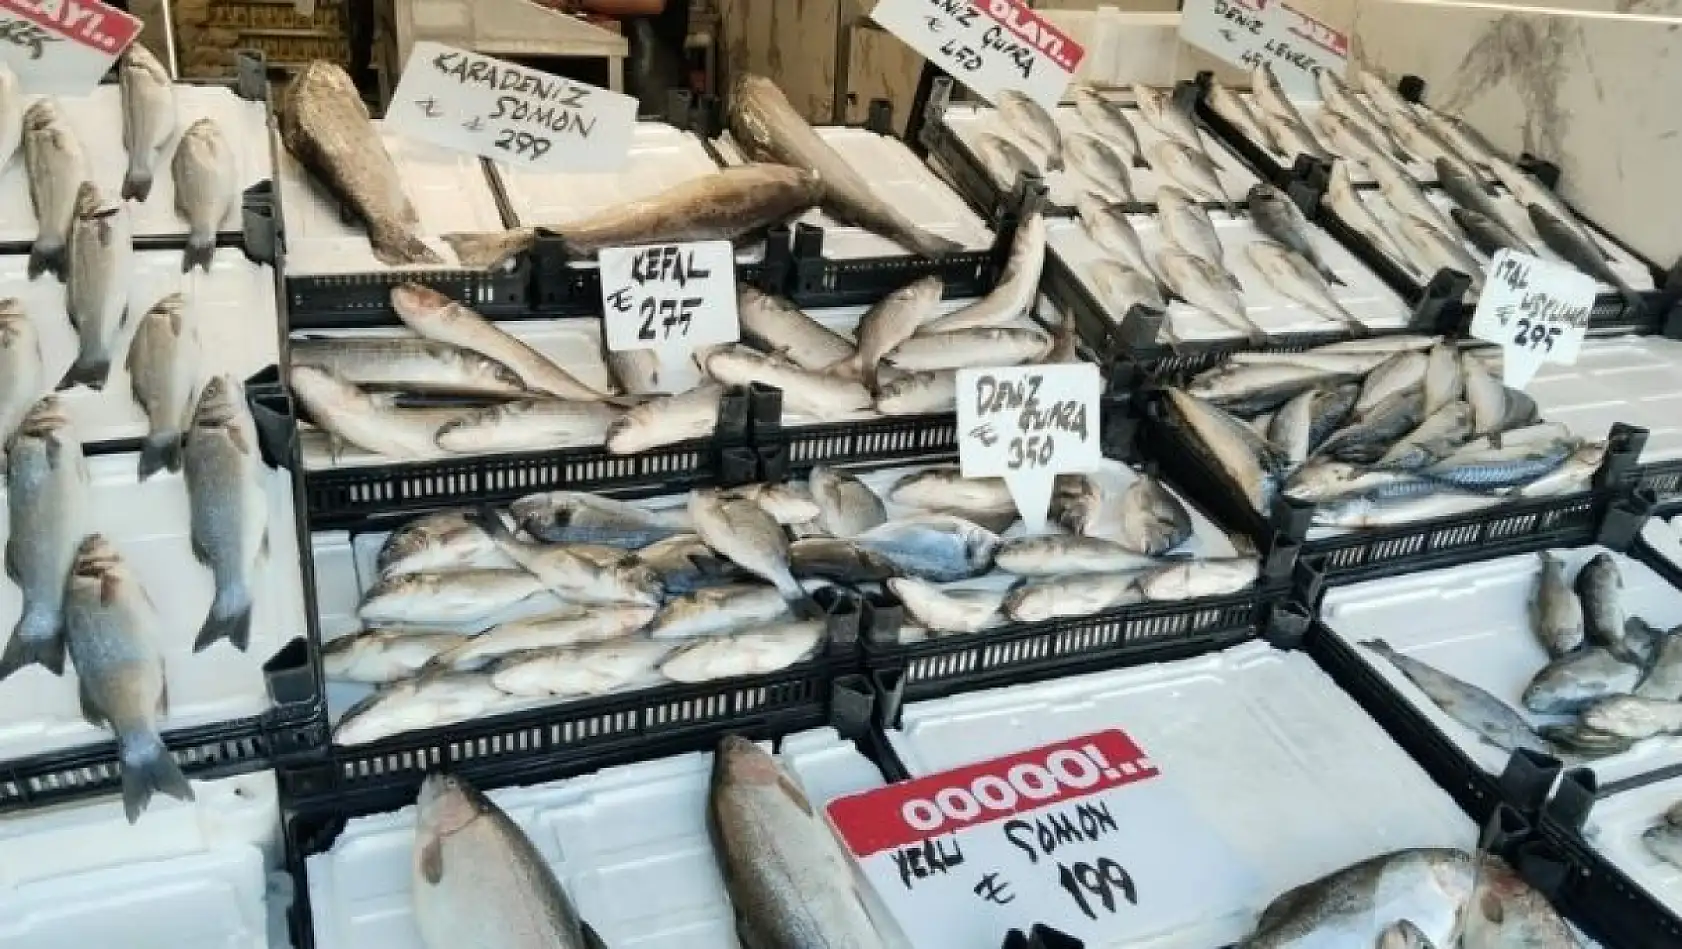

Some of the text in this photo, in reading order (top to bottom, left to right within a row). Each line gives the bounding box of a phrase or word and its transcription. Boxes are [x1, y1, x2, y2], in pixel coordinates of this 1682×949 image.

[489, 96, 596, 139] SOMON
[494, 129, 552, 162] 299
[631, 247, 711, 287] KEFAL
[638, 296, 704, 340] 275
[1514, 317, 1563, 353] 295
[1007, 434, 1054, 469] 350
[1003, 801, 1118, 864] SOMON
[1058, 856, 1139, 920] 199
